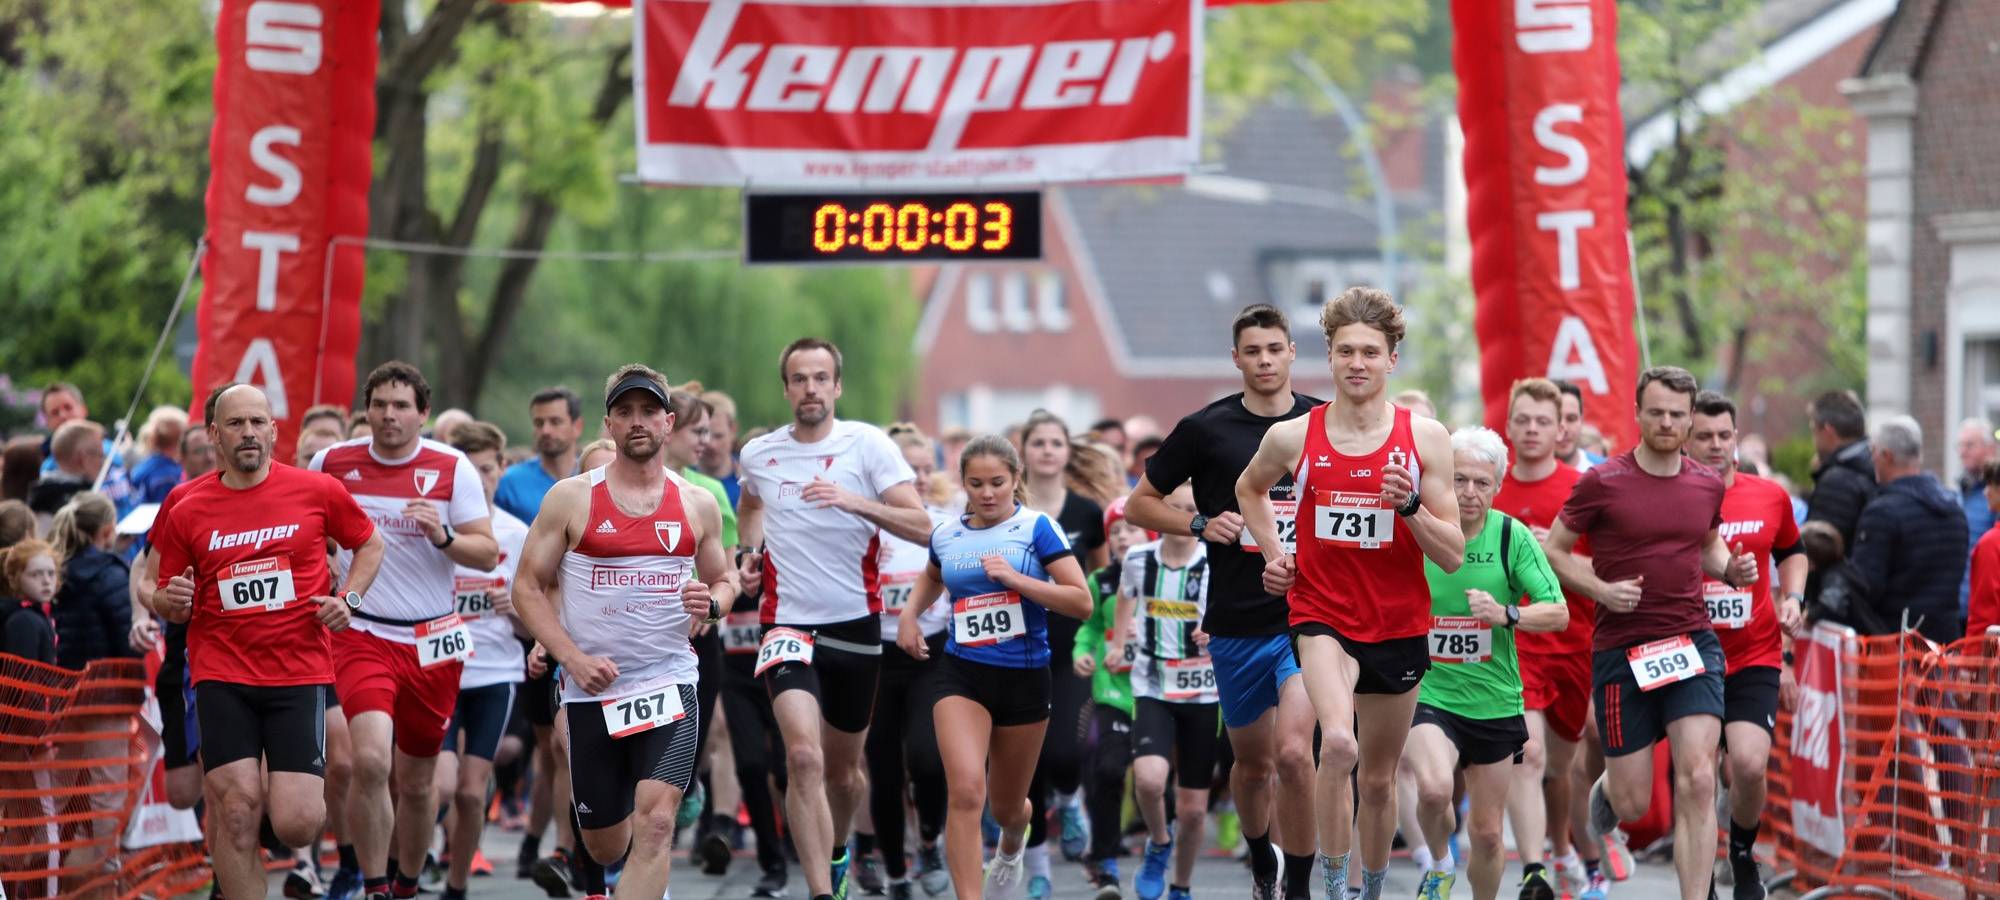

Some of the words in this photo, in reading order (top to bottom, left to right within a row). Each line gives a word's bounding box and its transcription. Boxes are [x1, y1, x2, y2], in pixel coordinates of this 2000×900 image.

[667, 0, 1175, 152] kemper
[814, 203, 1012, 252] 0:00:03
[1350, 469, 1372, 478] LGO
[1334, 494, 1380, 508] kemper
[208, 524, 299, 552] kemper
[1329, 512, 1376, 538] 731
[234, 561, 276, 575] kemper
[1466, 552, 1495, 564] SLZ
[233, 577, 279, 605] 607
[966, 610, 1012, 638] 549
[428, 631, 466, 658] 766
[762, 640, 801, 663] 576
[1433, 634, 1480, 655] 785
[1176, 670, 1215, 689] 558
[1644, 653, 1690, 680] 569
[616, 693, 665, 726] 767
